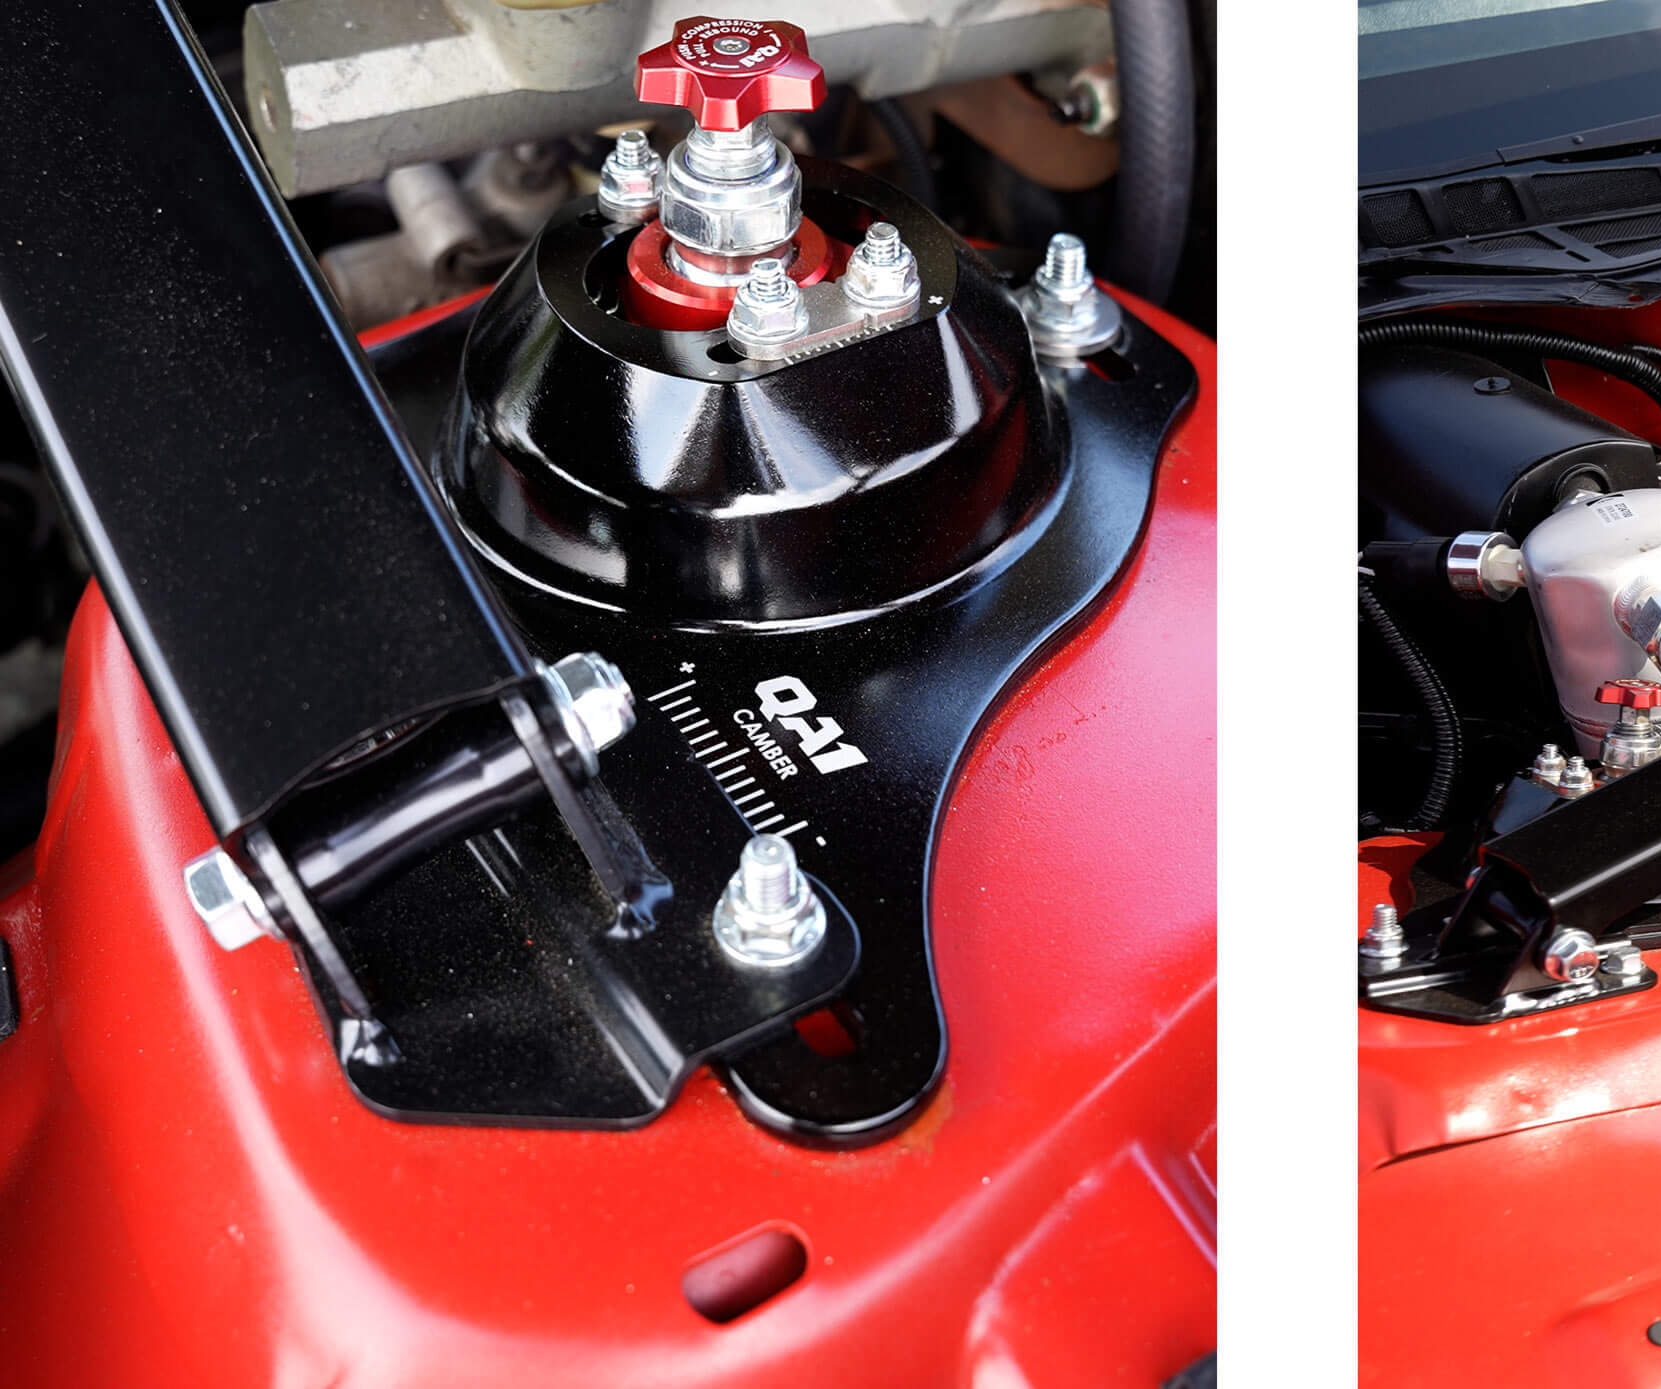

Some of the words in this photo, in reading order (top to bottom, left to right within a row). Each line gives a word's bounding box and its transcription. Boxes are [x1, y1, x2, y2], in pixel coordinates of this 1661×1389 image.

[682, 20, 764, 40] COMPRESSION
[699, 27, 759, 39] REBOUND
[732, 708, 799, 781] CAMBER
[754, 675, 869, 775] QA1
